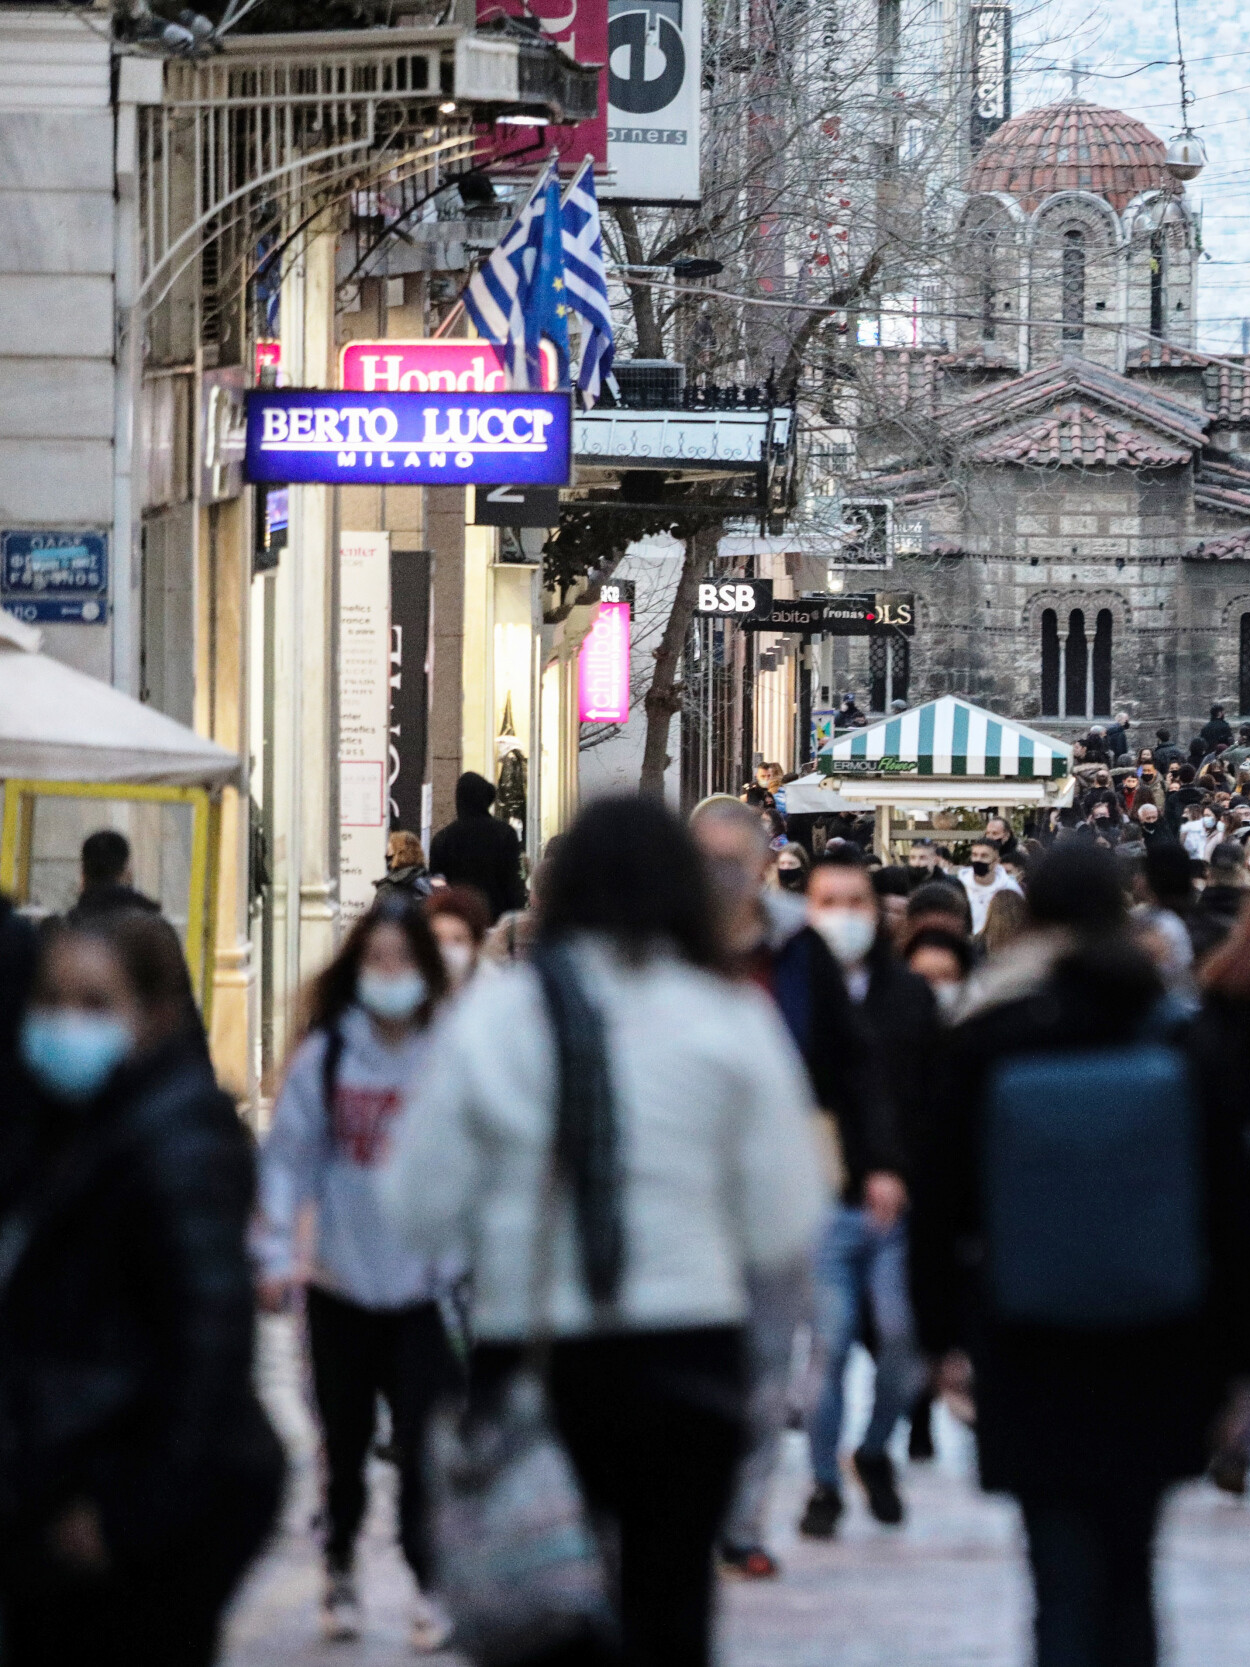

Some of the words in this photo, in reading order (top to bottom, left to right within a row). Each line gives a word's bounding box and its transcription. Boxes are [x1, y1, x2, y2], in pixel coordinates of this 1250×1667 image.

[262, 407, 398, 442] BERTO
[337, 452, 474, 468] MILANO
[699, 583, 756, 612] BSB
[834, 760, 877, 771] ERMOU
[878, 756, 917, 772] Flower
